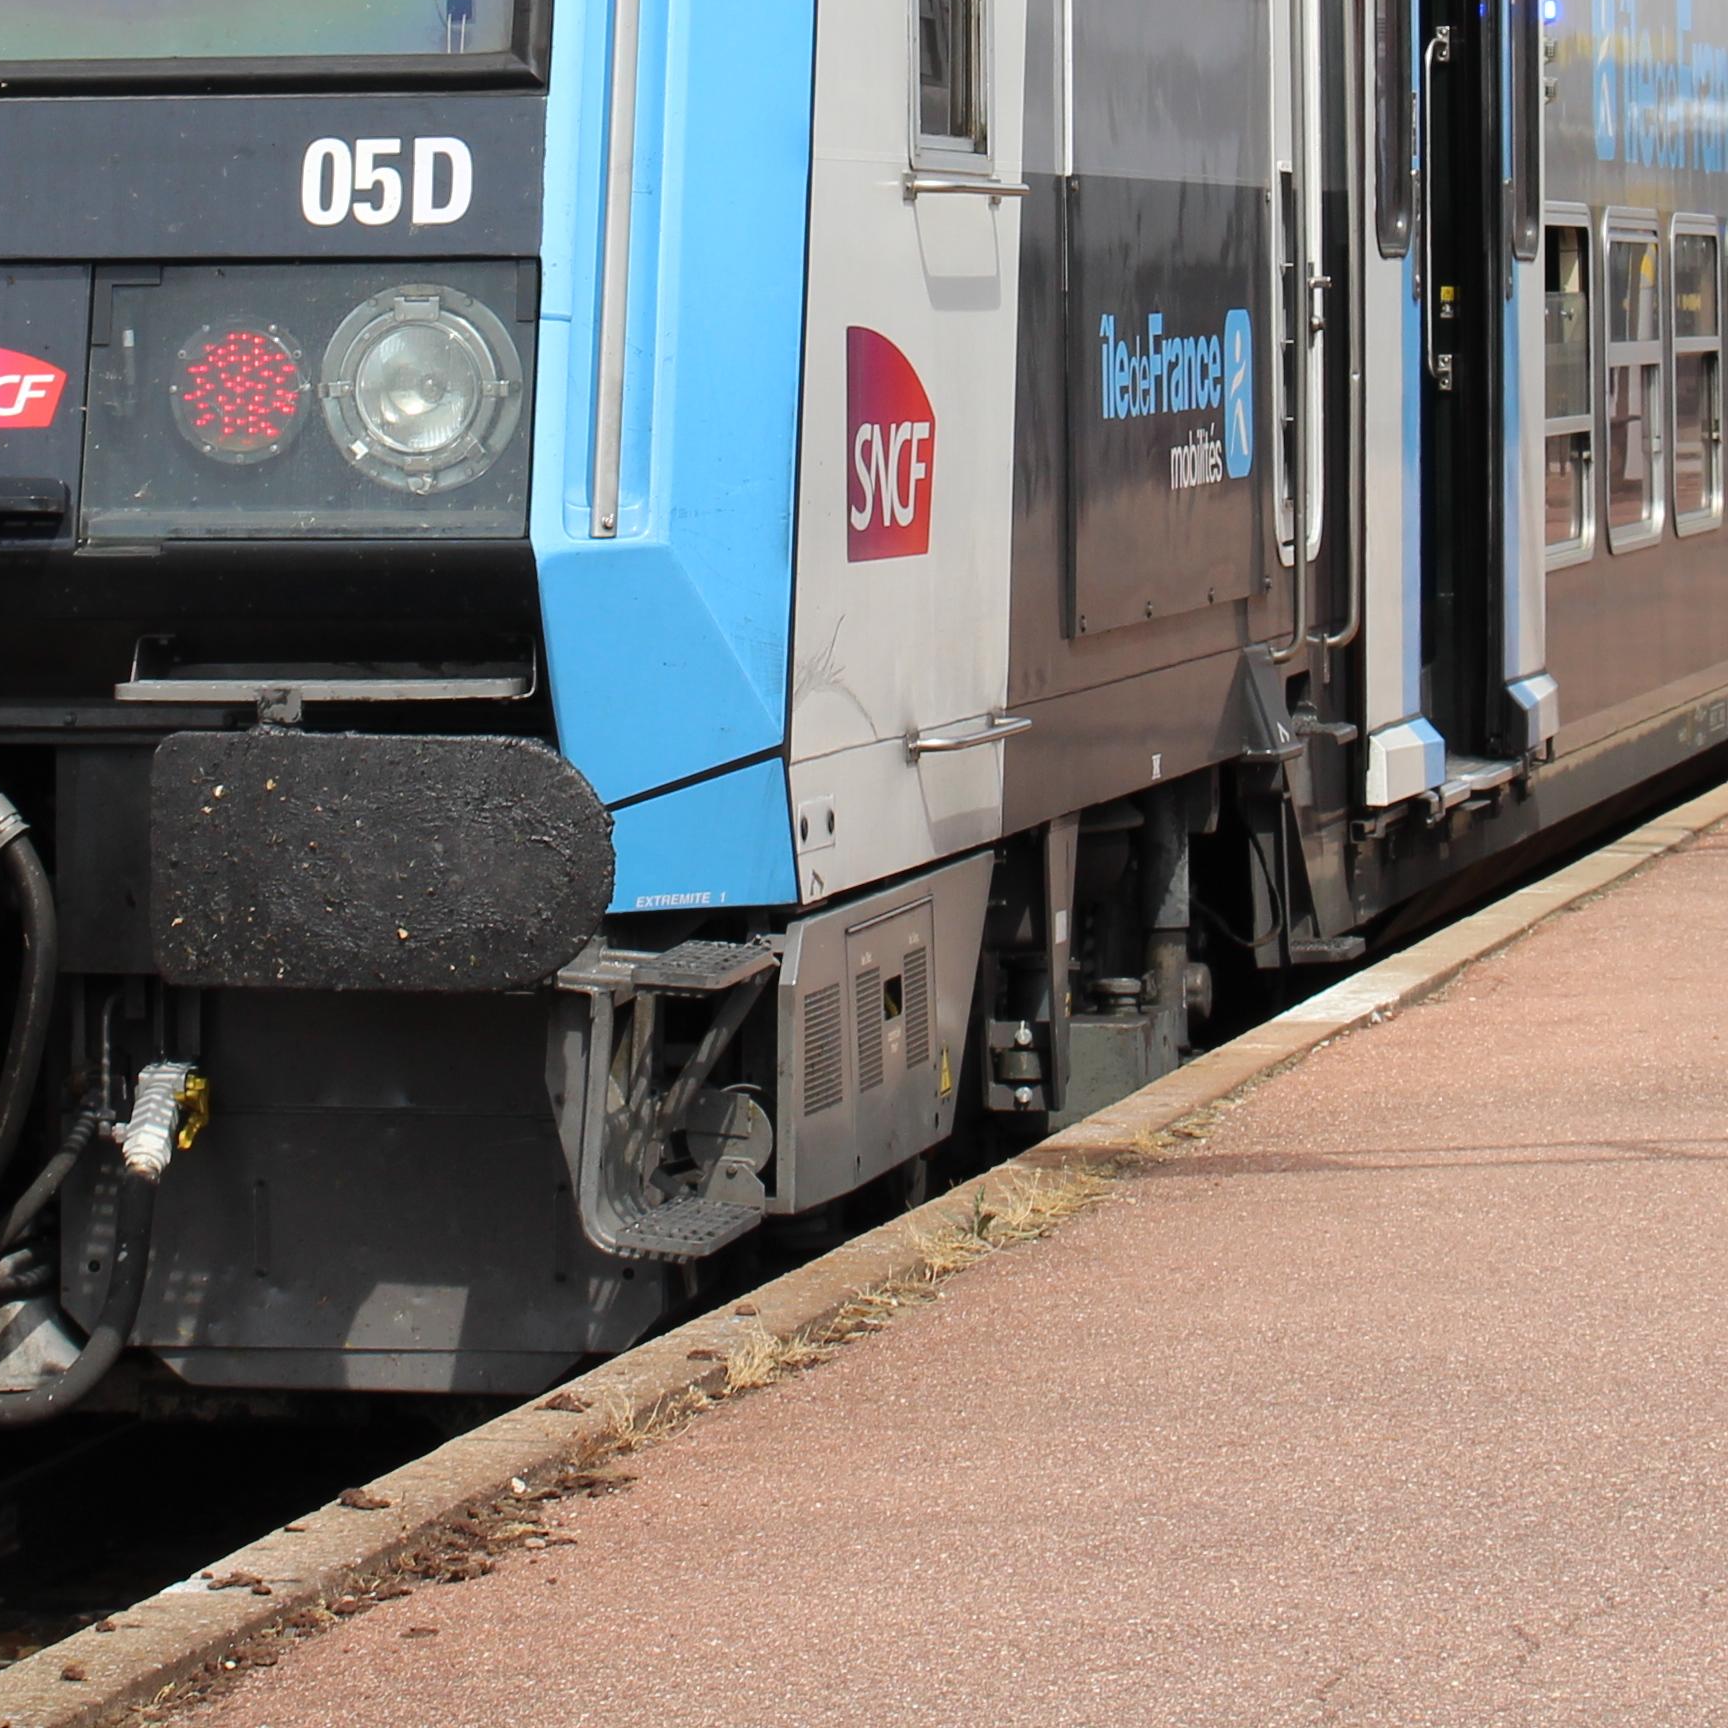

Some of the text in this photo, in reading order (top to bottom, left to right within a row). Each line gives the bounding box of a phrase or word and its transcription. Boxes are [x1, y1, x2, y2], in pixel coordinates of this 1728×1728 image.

[850, 421, 931, 531] SNCF
[1170, 422, 1223, 491] mobilités
[636, 891, 712, 909] EXTREMITE
